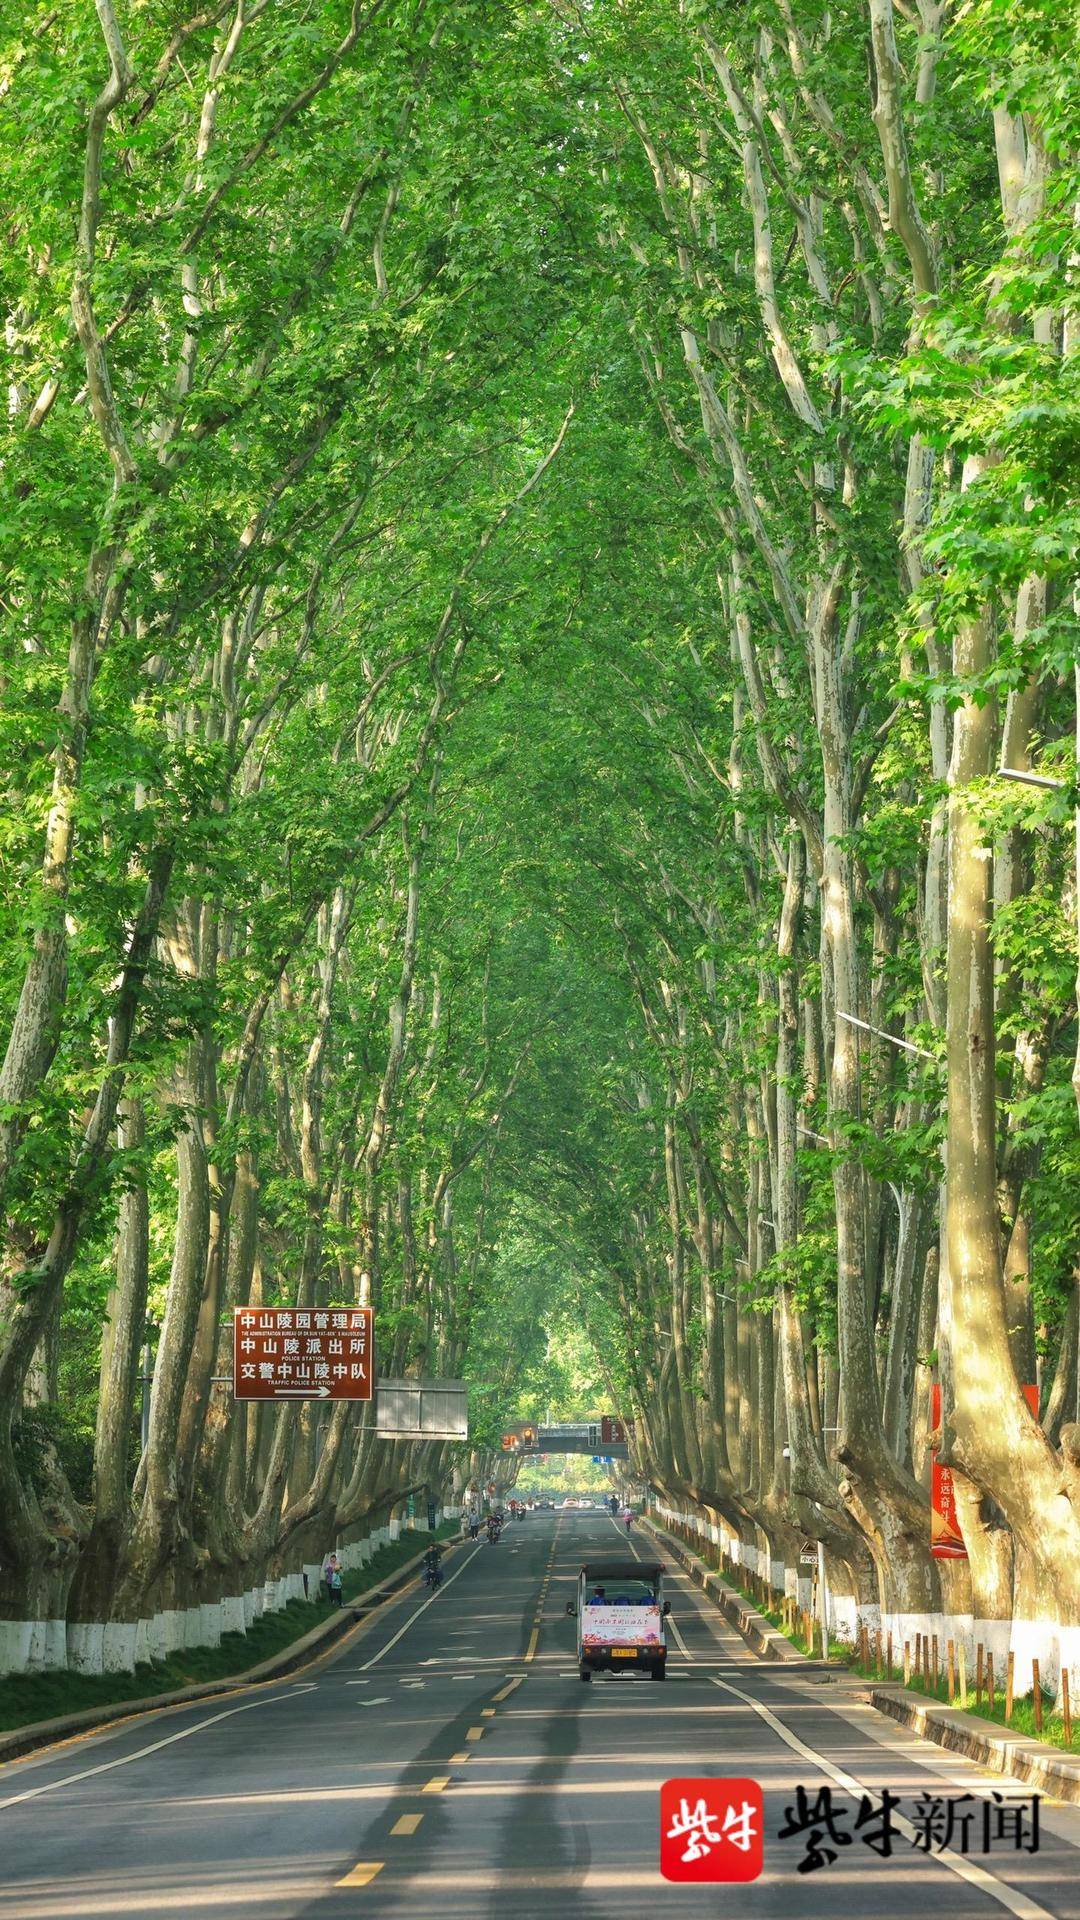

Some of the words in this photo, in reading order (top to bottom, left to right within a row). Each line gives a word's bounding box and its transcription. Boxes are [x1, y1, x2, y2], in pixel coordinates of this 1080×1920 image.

[241, 1313, 366, 1329] 中山陵园管理局
[241, 1338, 366, 1355] 中山陵派出所
[241, 1362, 367, 1379] 交警中山陵中队
[940, 1468, 951, 1521] 永远奋斗
